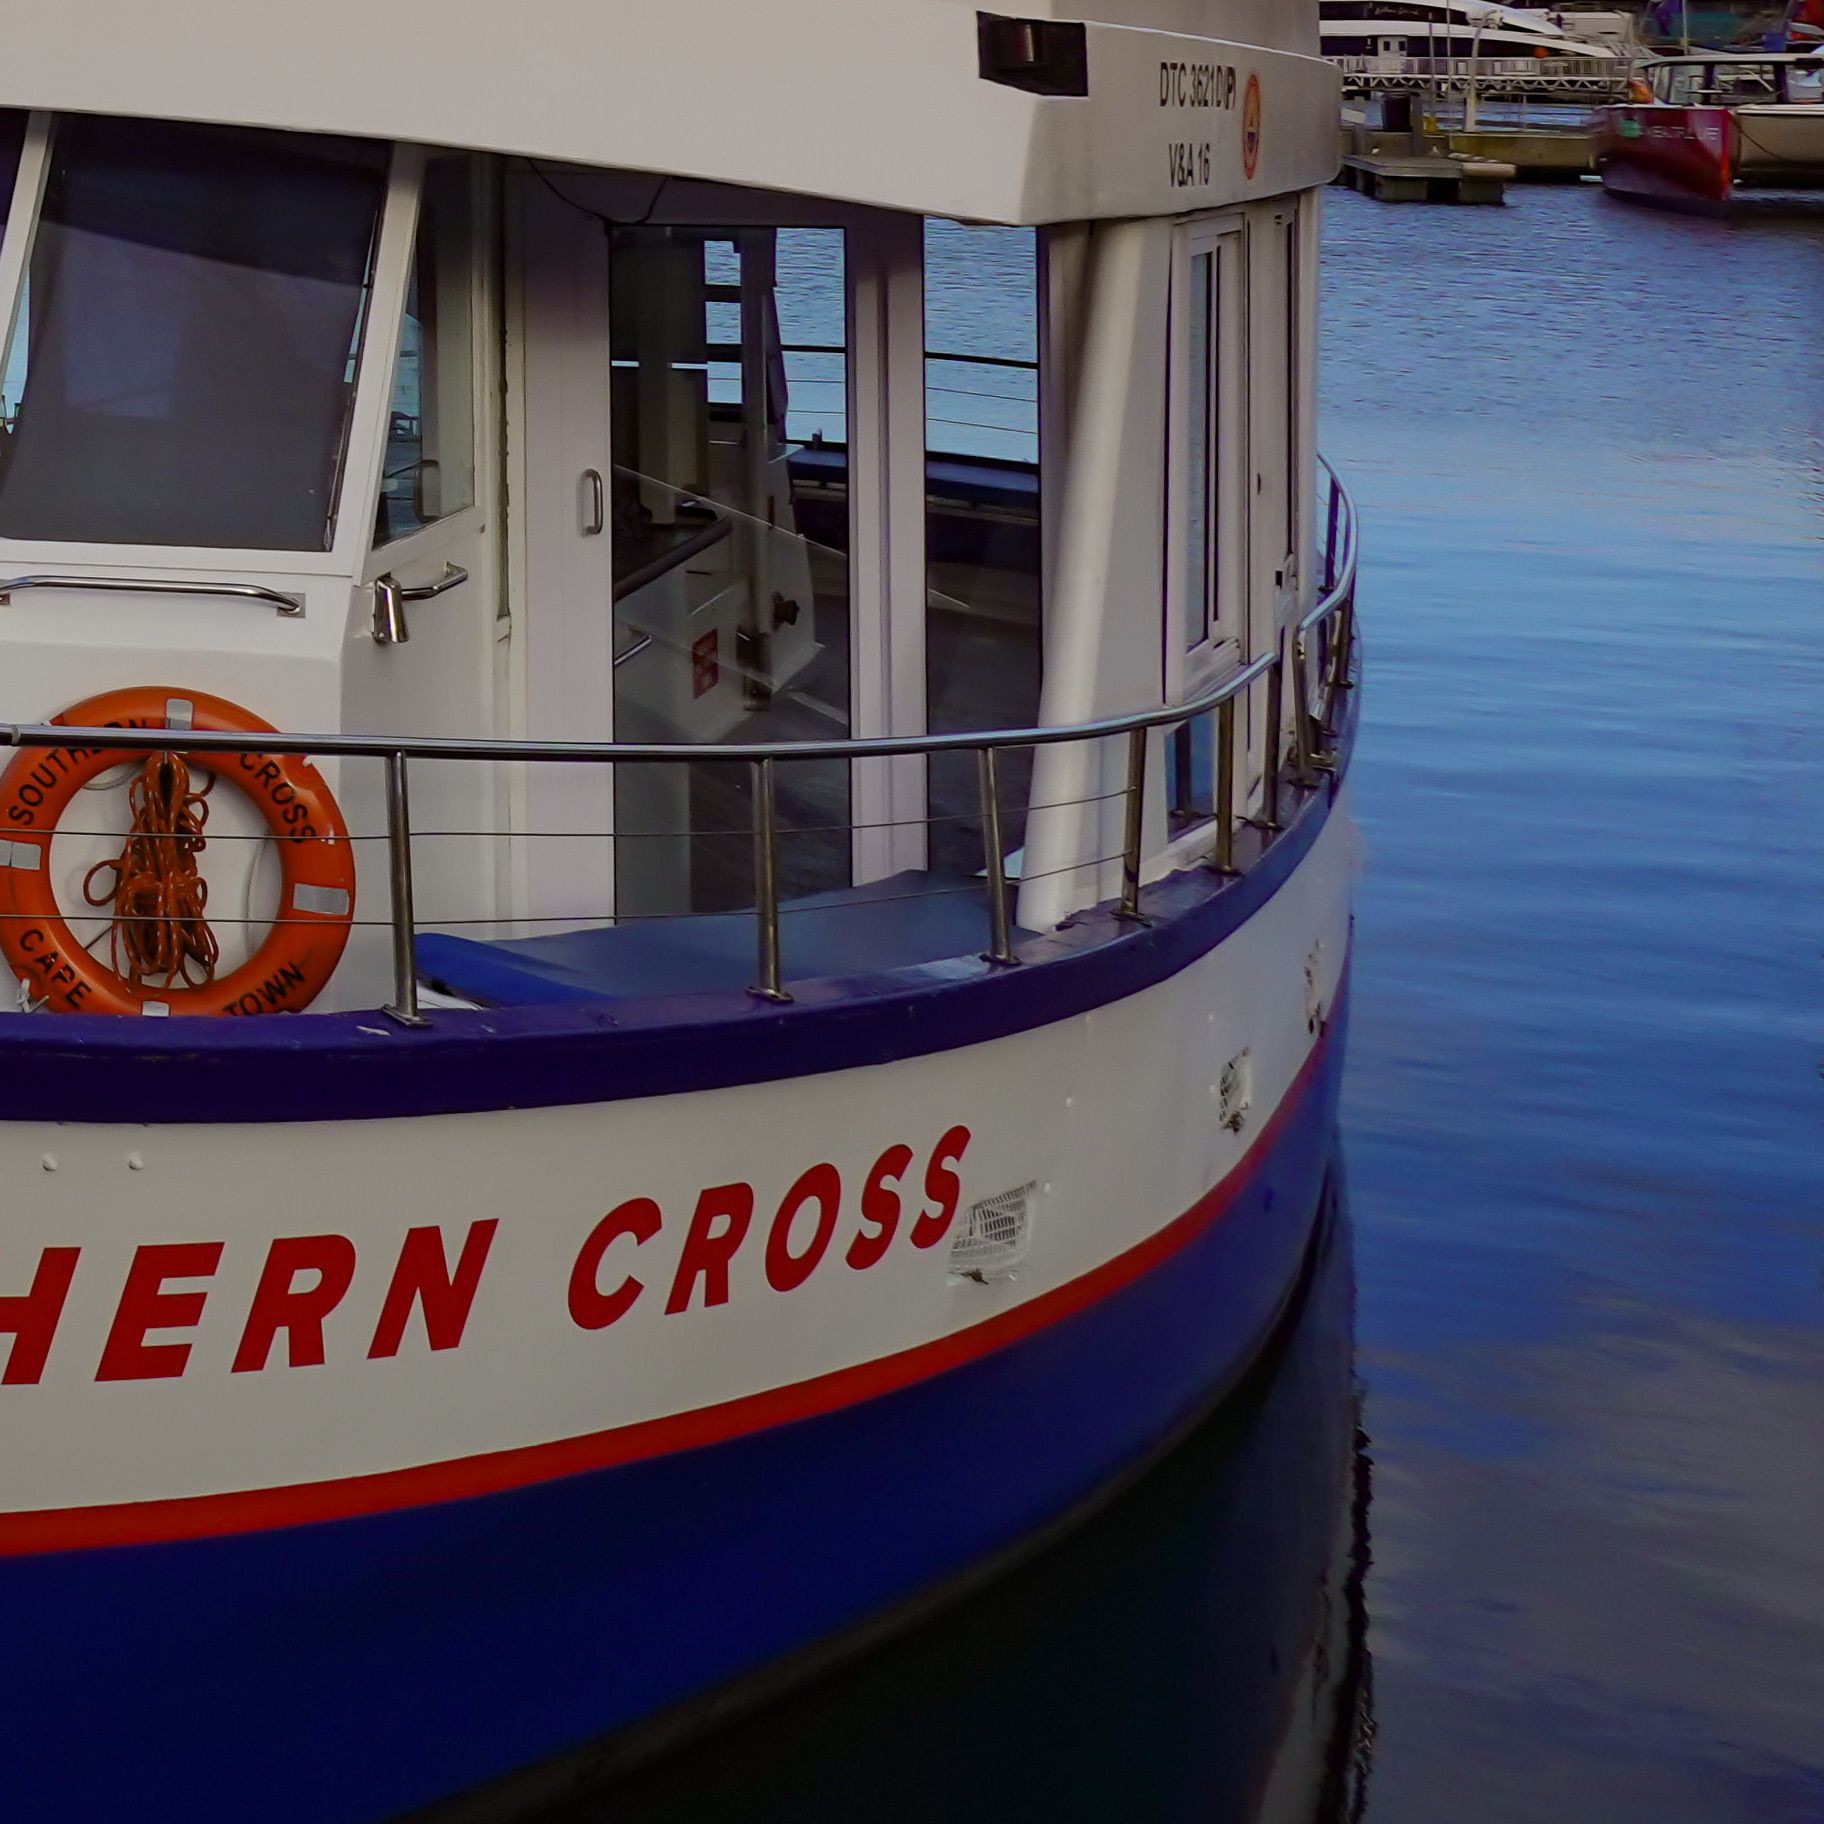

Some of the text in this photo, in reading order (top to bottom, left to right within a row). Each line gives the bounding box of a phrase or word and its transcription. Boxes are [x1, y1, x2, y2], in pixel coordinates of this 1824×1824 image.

[1160, 62, 1187, 107] DTC
[1168, 142, 1210, 187] V&A 16
[19, 927, 93, 1010] CAPE
[567, 1124, 971, 1331] CROSS
